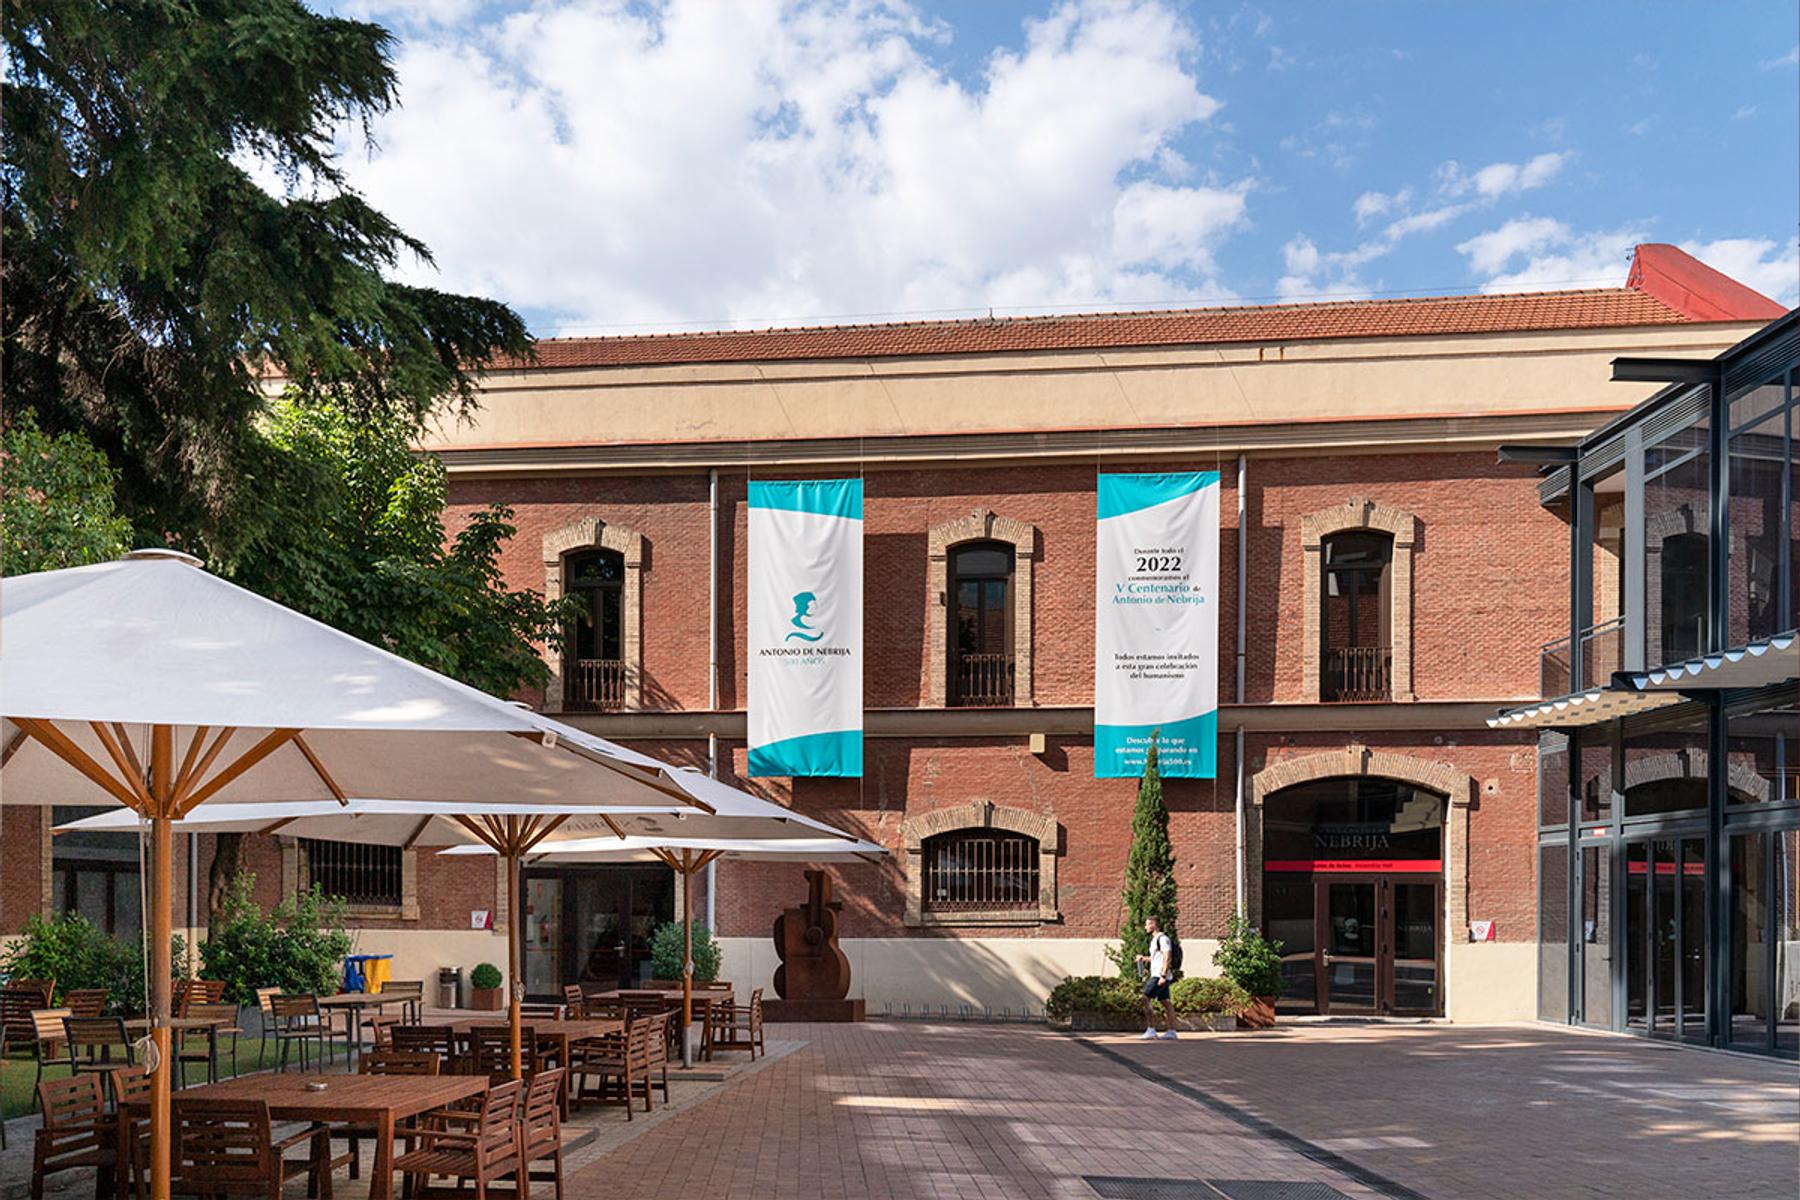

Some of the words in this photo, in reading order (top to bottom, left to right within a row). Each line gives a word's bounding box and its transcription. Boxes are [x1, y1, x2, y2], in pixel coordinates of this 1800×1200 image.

[1136, 556, 1182, 572] 2022
[1182, 573, 1190, 581] el
[1116, 583, 1125, 593] V
[1127, 582, 1191, 593] Centenario
[1112, 594, 1153, 604] Antonio
[1154, 595, 1165, 604] de
[1167, 593, 1206, 606] Nebrija
[759, 647, 801, 656] ANTONIO
[802, 647, 815, 656] DE
[816, 647, 851, 656] NEBRIJA
[1166, 652, 1200, 660] invitados
[1137, 663, 1155, 671] gran
[1129, 671, 1142, 679] del
[1126, 736, 1160, 744] Descube
[1314, 834, 1391, 851] NEBRIJA
